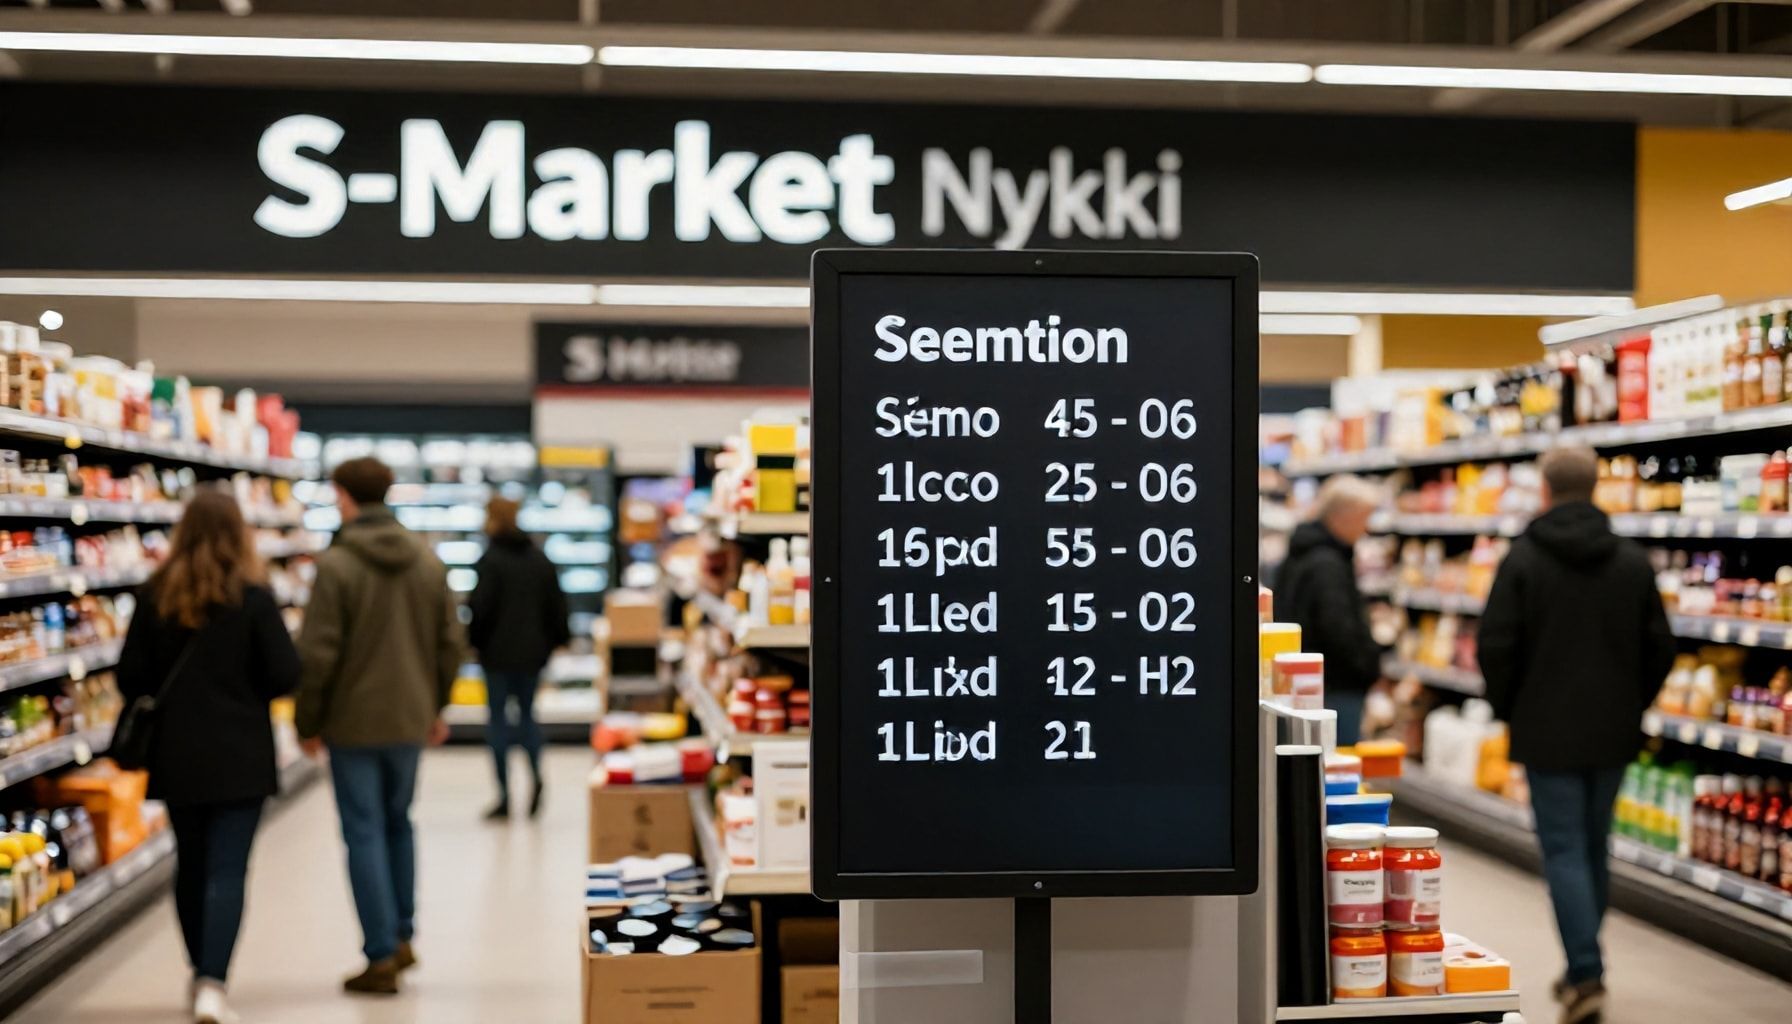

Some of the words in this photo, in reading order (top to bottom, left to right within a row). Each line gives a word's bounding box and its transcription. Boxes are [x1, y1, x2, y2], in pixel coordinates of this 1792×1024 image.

[254, 113, 895, 244] S-Market
[921, 147, 1182, 249] Nykki
[874, 315, 1128, 363] Seemtion
[1044, 398, 1098, 438] 45
[1139, 398, 1197, 439] 06
[1045, 462, 1098, 503] 25
[1139, 463, 1197, 503] 06
[1045, 528, 1097, 567] 55
[1139, 528, 1197, 567] 06
[1046, 592, 1097, 632] 15
[1139, 592, 1197, 632] 02
[1139, 656, 1197, 695] H2
[1044, 720, 1097, 760] 21
